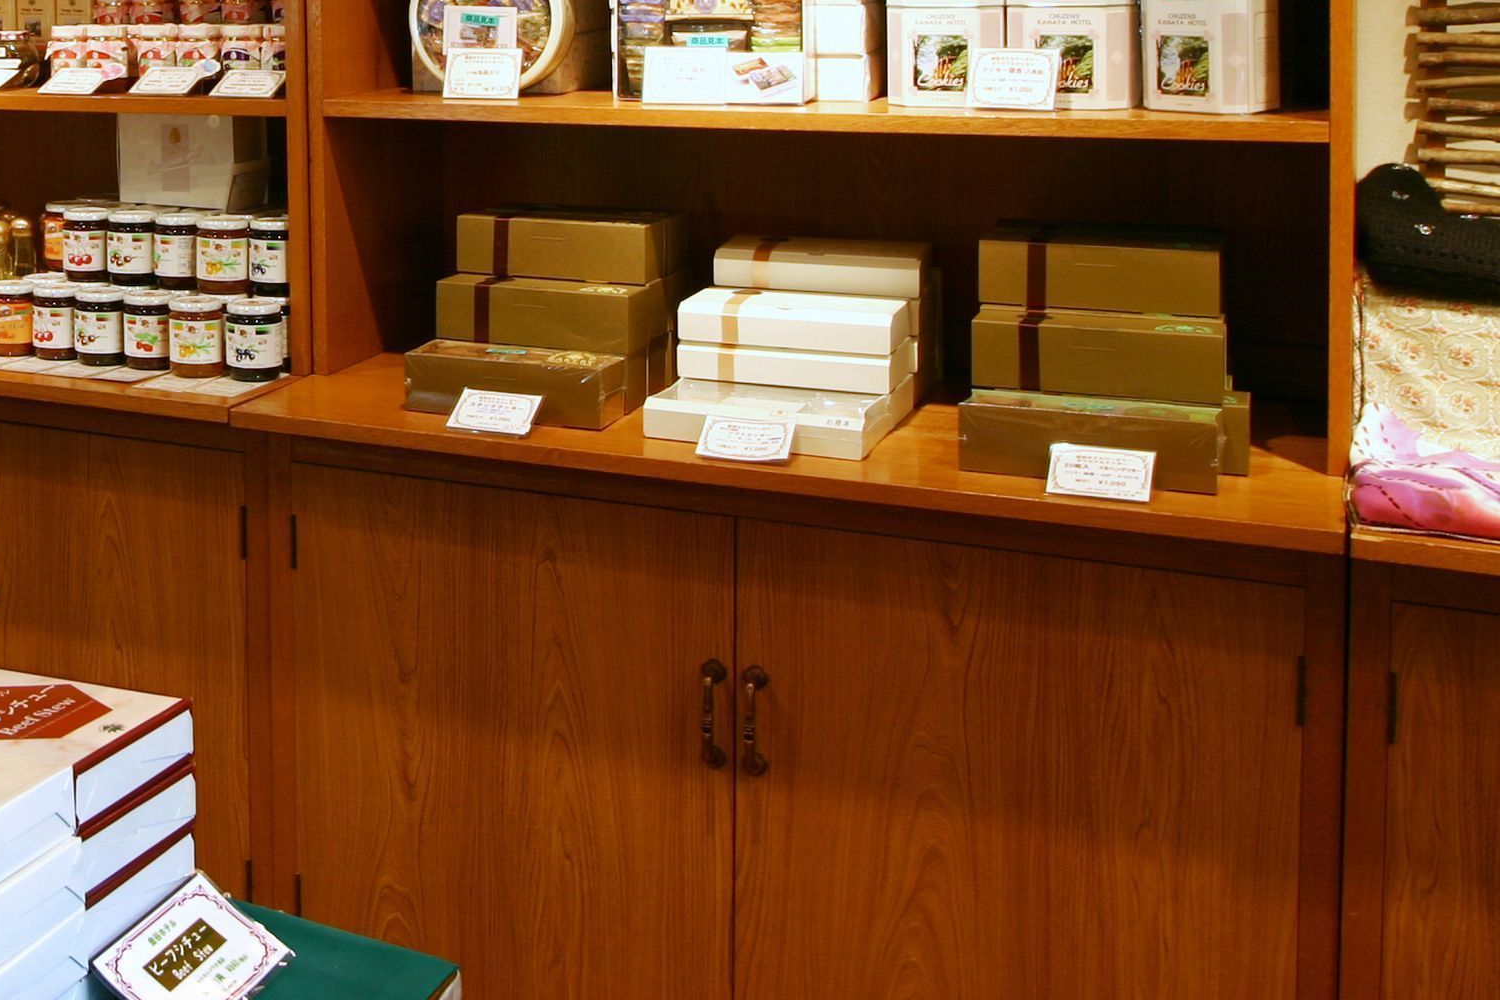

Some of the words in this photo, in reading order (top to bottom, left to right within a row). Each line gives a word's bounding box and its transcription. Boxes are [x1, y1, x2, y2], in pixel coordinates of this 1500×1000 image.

[917, 72, 964, 87] Cookies
[1161, 75, 1206, 91] Cookies
[32, 697, 76, 719] Stew
[149, 925, 208, 976] ビーフシチュー
[171, 959, 194, 981] Beef
[192, 943, 214, 963] Stew
